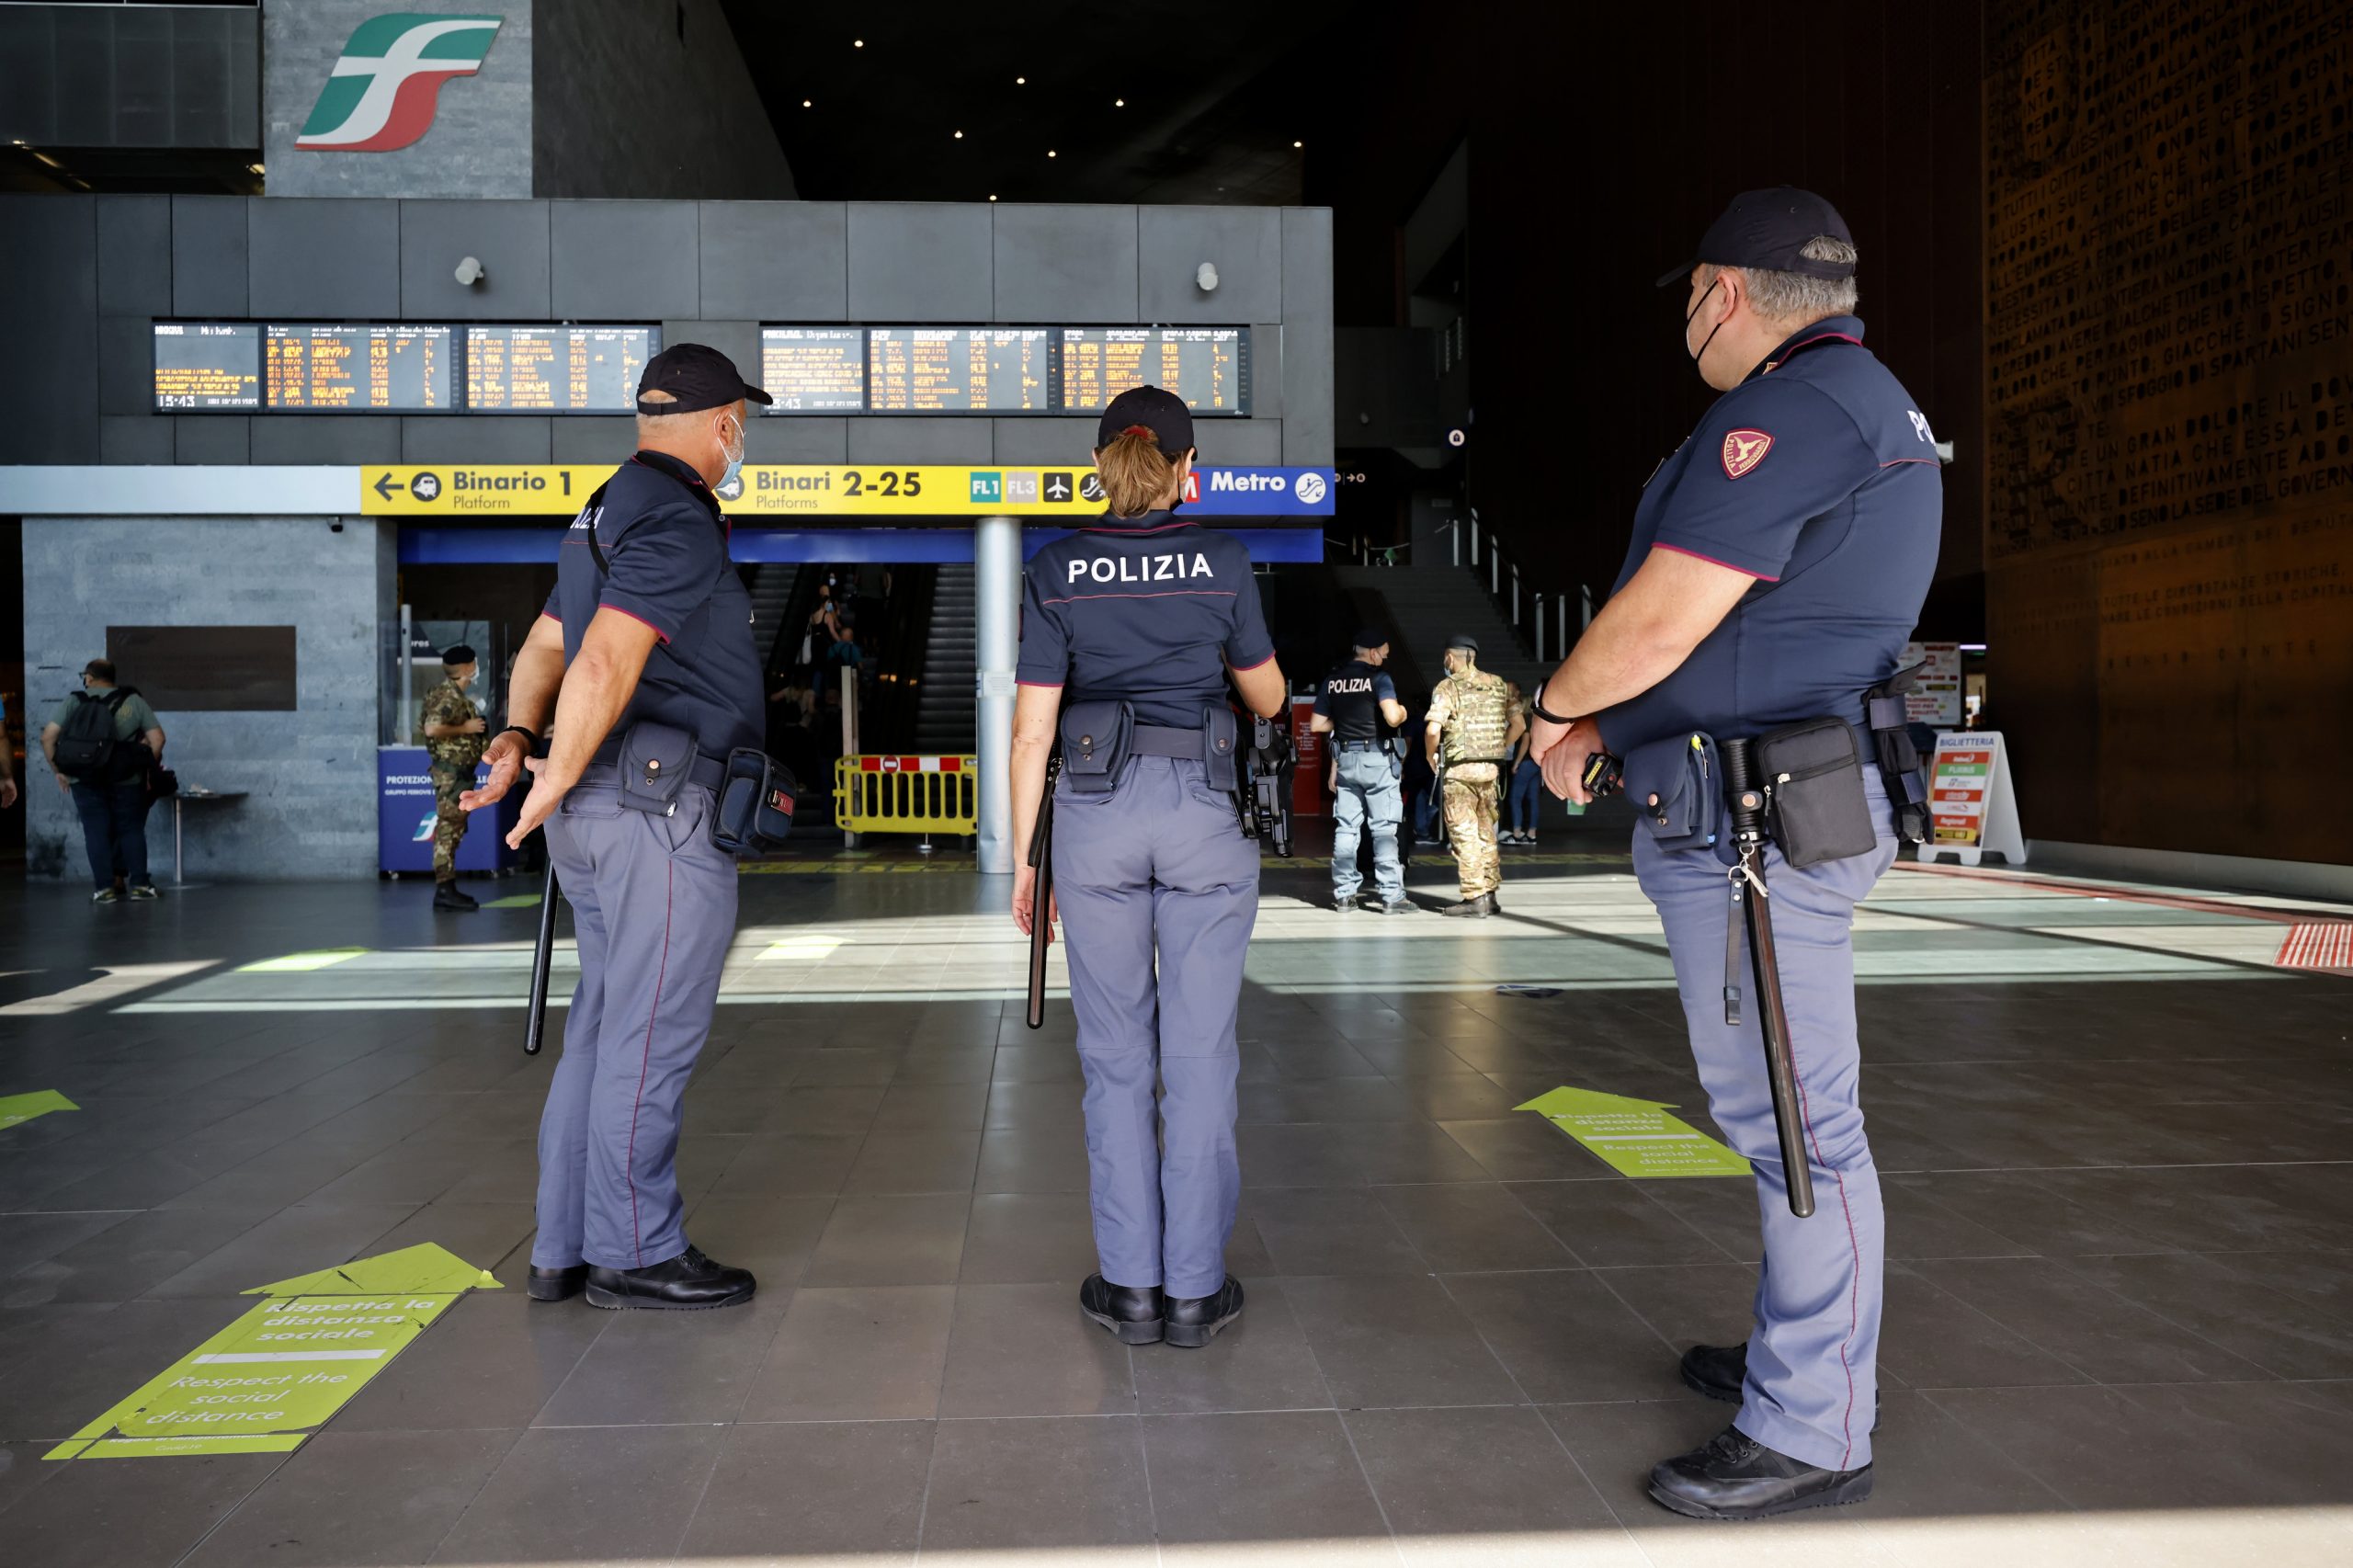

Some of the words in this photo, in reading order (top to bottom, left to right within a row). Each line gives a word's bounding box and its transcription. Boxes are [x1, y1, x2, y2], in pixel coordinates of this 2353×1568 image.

[2168, 0, 2240, 54] PROCLA
[2123, 42, 2244, 131] CIRCOSTANZA
[2251, 0, 2343, 59] APPELL
[2087, 71, 2151, 127] DAVANTI
[2156, 41, 2199, 87] ALLA
[1988, 201, 2051, 252] ILLUSTRI
[2057, 181, 2089, 216] SUE
[2155, 118, 2208, 165] ONDE
[2219, 79, 2279, 132] CESSI
[2289, 43, 2347, 97] OGNI
[2003, 186, 2037, 222] TUTTI
[2049, 140, 2119, 197] CITTADINI
[2211, 72, 2241, 108] DEI
[2198, 131, 2234, 170] NOI
[2164, 178, 2194, 212] CHI
[2200, 163, 2224, 196] HA
[2097, 223, 2154, 269] FRONTE
[2159, 196, 2213, 242] DELLE
[2218, 162, 2287, 215] ESTERE
[2086, 261, 2124, 298] AVER
[2131, 237, 2177, 278] ROMA
[2186, 219, 2221, 256] PER
[2228, 170, 2330, 237] CAPITALE
[2001, 346, 2040, 379] CREDO
[2058, 322, 2100, 357] AVERE
[2103, 293, 2171, 340] QUALCHE
[2175, 269, 2232, 312] TITOLO
[2251, 237, 2312, 283] POTER
[1989, 370, 2037, 405] COLORO
[2075, 346, 2103, 375] PER
[2108, 320, 2171, 363] RAGIONI
[2176, 305, 2211, 338] CHE
[2216, 296, 2234, 324] IO
[2117, 368, 2184, 408] SFOGGIO
[2188, 360, 2205, 385] DI
[2209, 328, 2302, 379] SPARTANI
[2307, 312, 2353, 347] SEN
[2097, 438, 2118, 463] UN
[2127, 422, 2176, 455] GRAN
[2185, 395, 2268, 439] DOLORE
[2278, 387, 2300, 415] IL
[2125, 447, 2182, 481] NATIA
[2191, 433, 2233, 464] CHE
[2244, 415, 2302, 451] ESSA
[2315, 402, 2353, 434] DE
[453, 471, 546, 491] Binario
[560, 471, 571, 495] 1
[756, 471, 831, 491] Binari
[843, 471, 922, 496] 2-25
[972, 480, 999, 494] FL1
[1007, 481, 1036, 494] FL3
[1211, 471, 1287, 492] Metro
[2118, 448, 2289, 507] DEFINITIVAMENTE
[2298, 438, 2326, 467] AD
[453, 495, 511, 509] Platform
[756, 495, 818, 509] Platforms
[2099, 511, 2127, 536] SUO
[2129, 502, 2169, 529] SENO
[2171, 496, 2191, 521] LA
[2194, 487, 2237, 517] SEDE
[2240, 479, 2274, 507] DEL
[1068, 552, 1213, 584] POLIZIA
[1328, 677, 1372, 695] POLIZIA
[1939, 738, 1995, 746] BIGLIETTERIA
[386, 776, 433, 785] PROTEZION
[263, 1315, 405, 1326] distanza
[264, 1300, 396, 1313] Rispetta
[404, 1299, 436, 1309] la
[256, 1327, 375, 1341] sociale
[168, 1374, 292, 1389] Respect
[297, 1371, 348, 1384] the
[188, 1389, 291, 1404] social
[145, 1410, 285, 1425] distance
